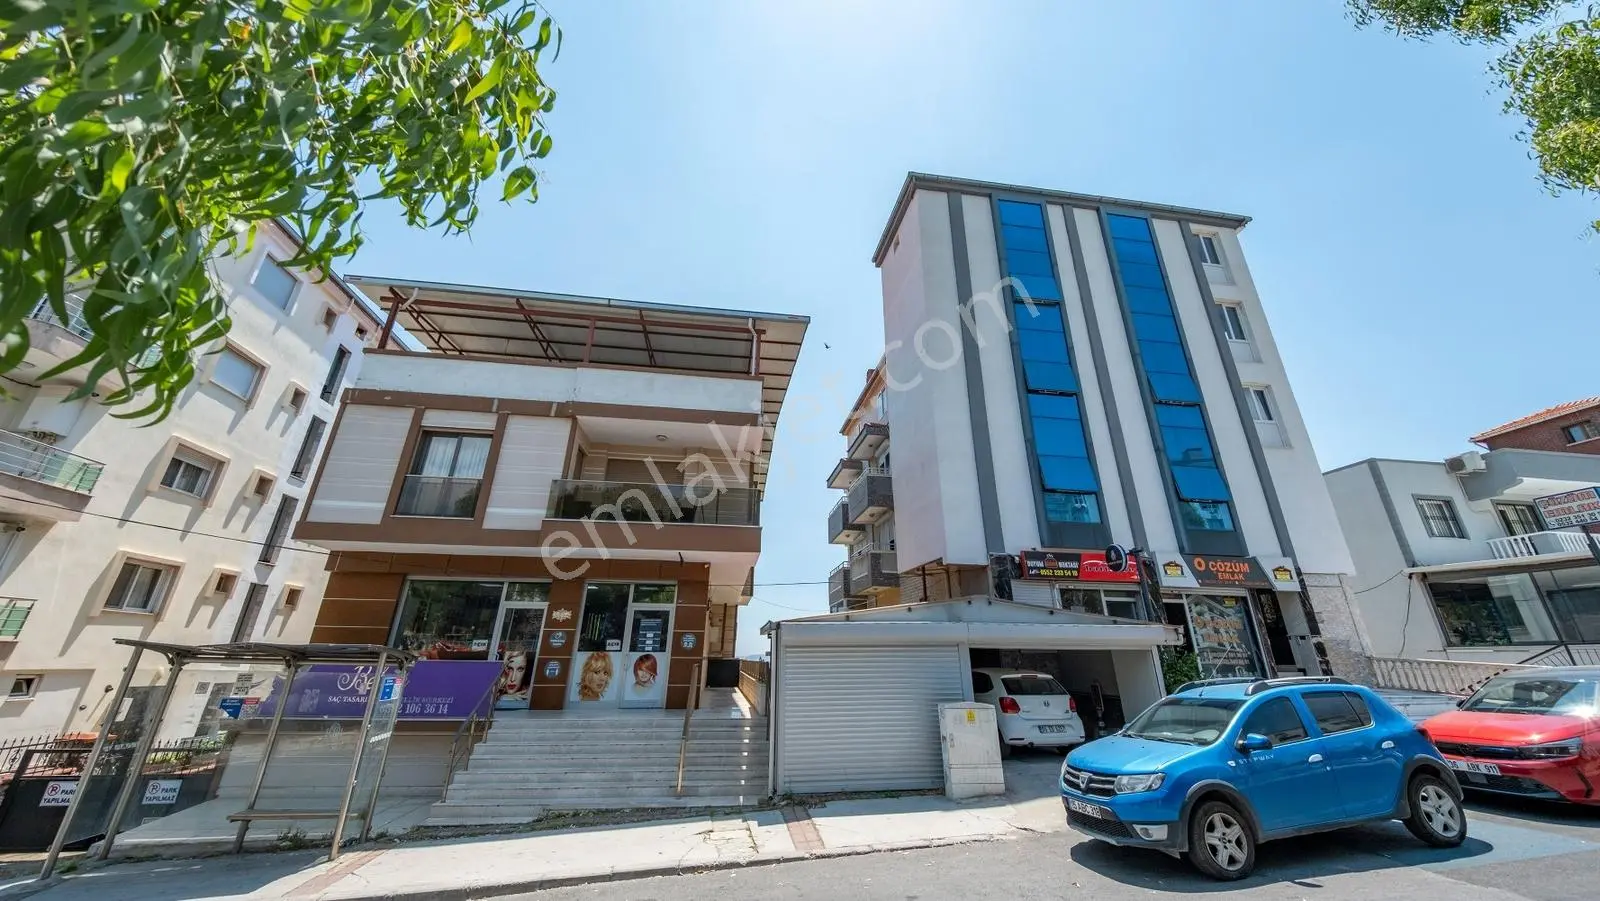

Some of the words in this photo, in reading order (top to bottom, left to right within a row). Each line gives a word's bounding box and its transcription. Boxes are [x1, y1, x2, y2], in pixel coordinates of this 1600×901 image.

[1208, 559, 1250, 574] ÇÖZÜM
[1217, 572, 1245, 580] EMLAK
[405, 703, 421, 713] 106
[424, 703, 436, 713] 36
[437, 703, 449, 713] 14
[1484, 764, 1498, 773] 911
